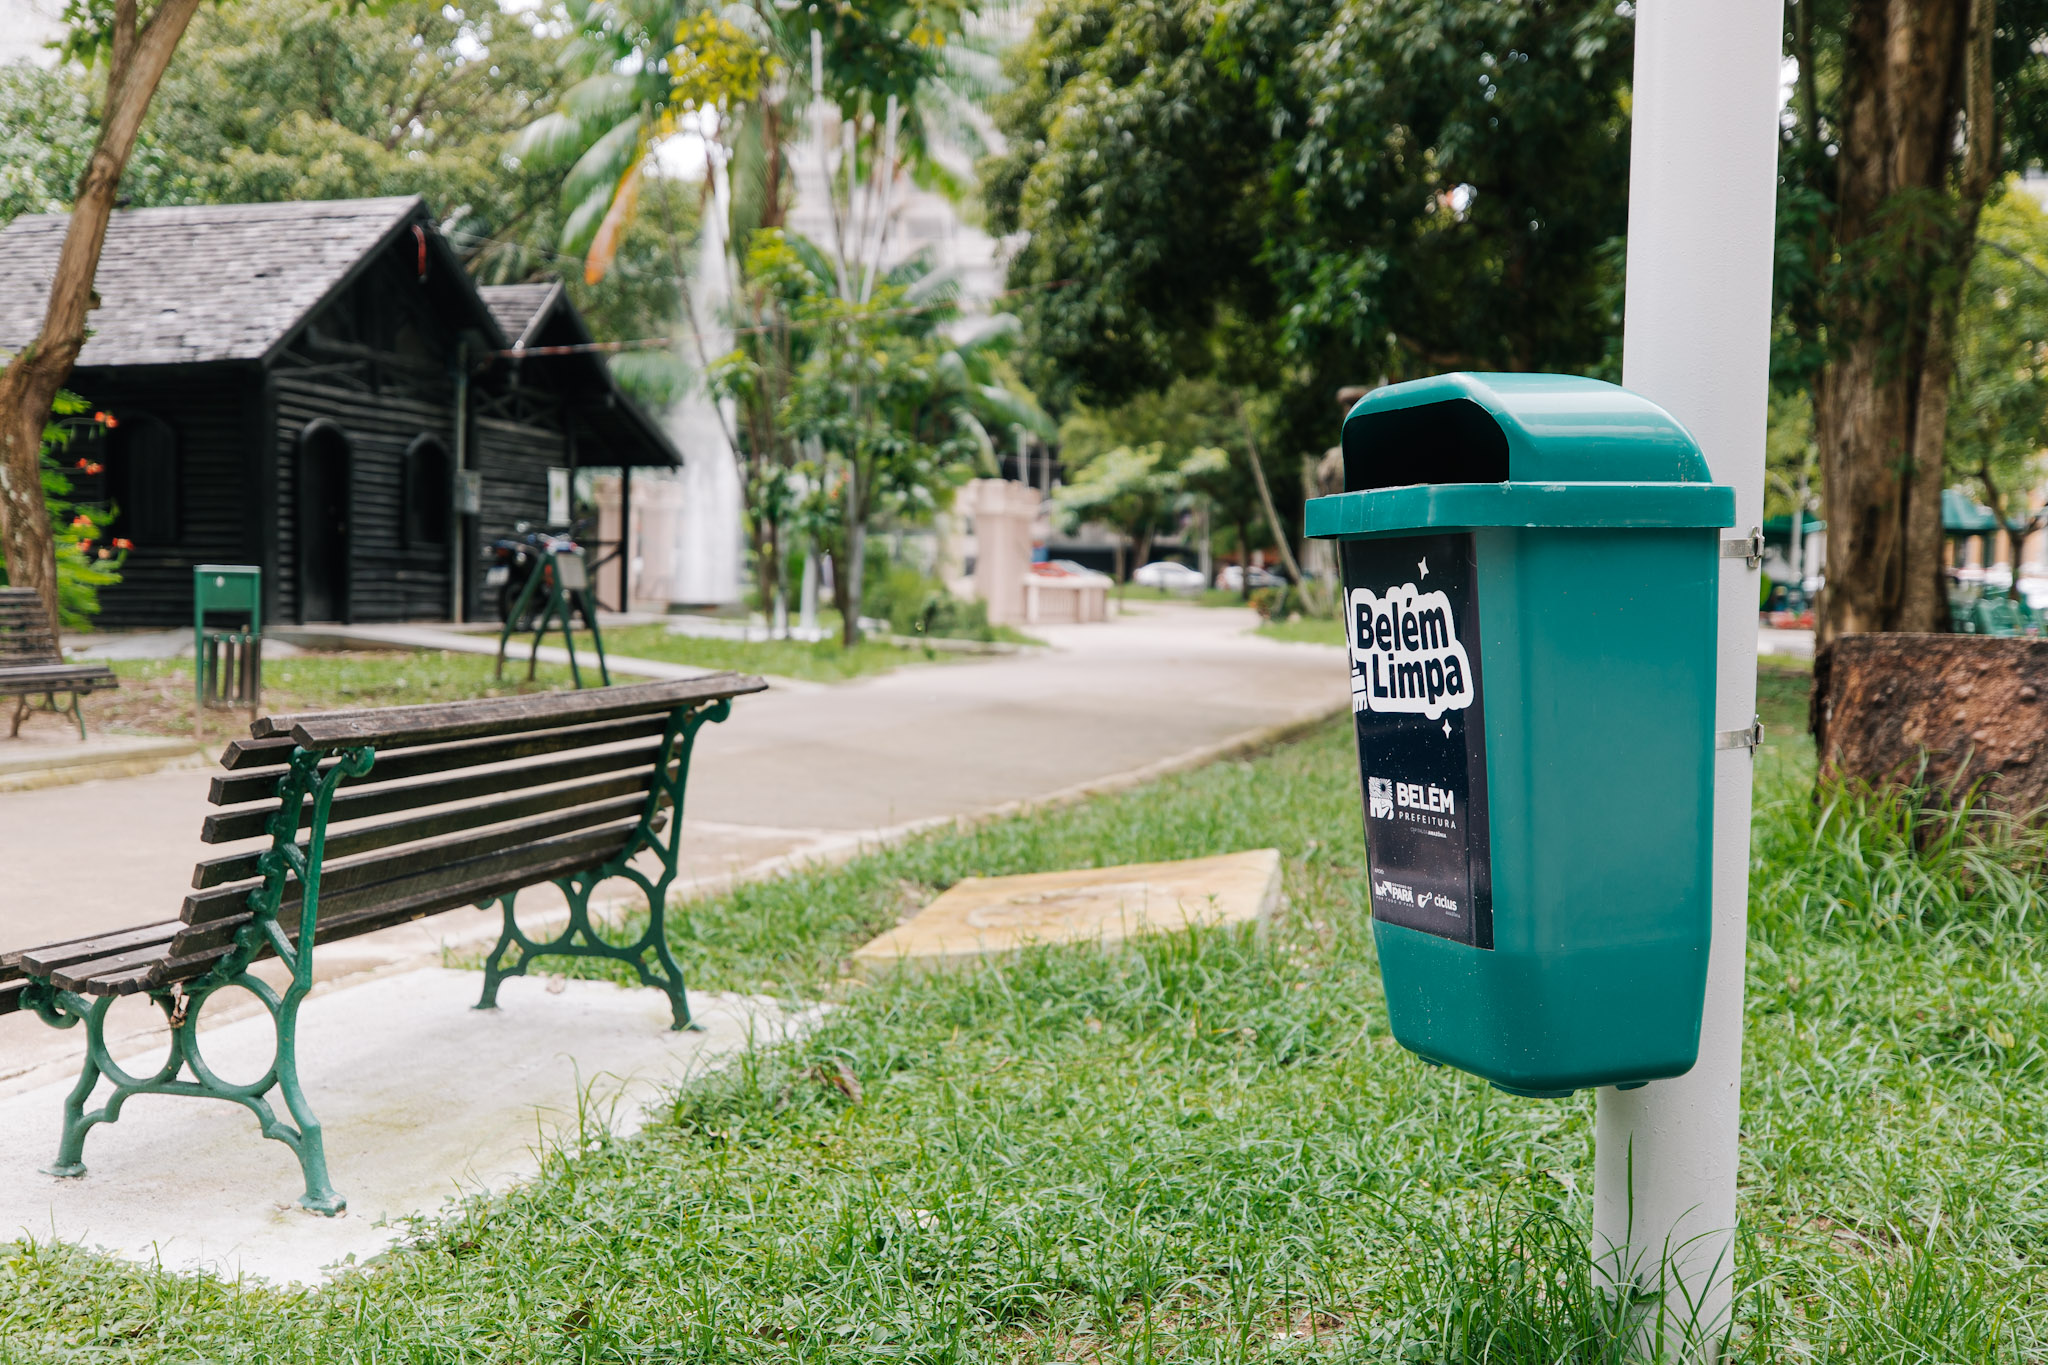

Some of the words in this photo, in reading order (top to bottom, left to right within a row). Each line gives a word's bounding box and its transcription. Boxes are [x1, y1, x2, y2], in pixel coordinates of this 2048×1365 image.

[1356, 597, 1449, 651] Belém
[1372, 653, 1465, 704] Limpa
[1396, 782, 1455, 815] BELÉM
[1398, 811, 1457, 830] PREFEITURA
[1434, 893, 1458, 911] ciclus
